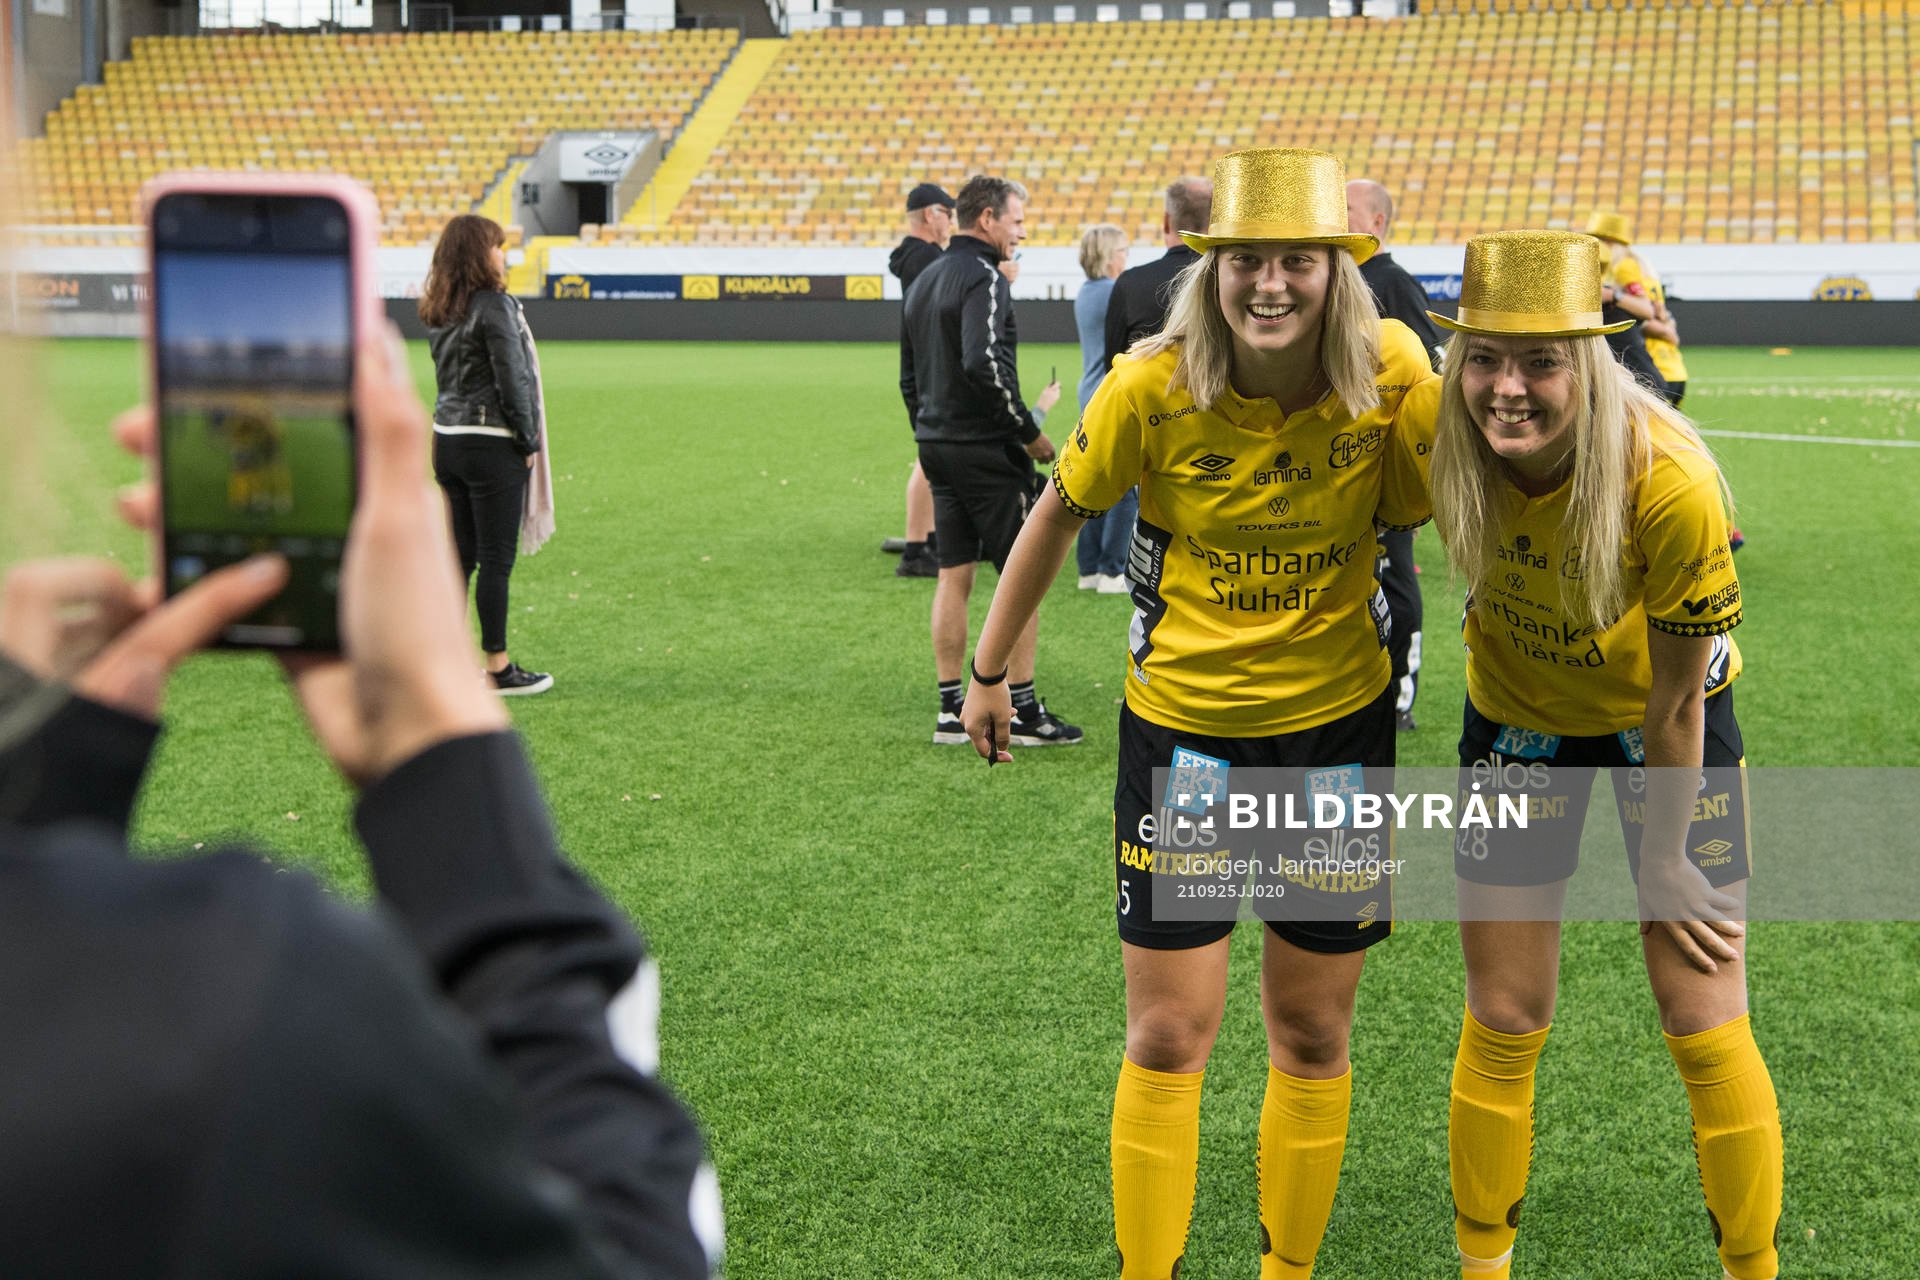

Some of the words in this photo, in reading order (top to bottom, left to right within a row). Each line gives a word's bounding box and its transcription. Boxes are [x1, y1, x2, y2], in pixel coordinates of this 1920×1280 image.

[1328, 428, 1382, 469] Elfsborg
[1195, 471, 1232, 482] umbro
[1253, 465, 1312, 487] lamina
[1236, 521, 1300, 531] TOVEKS
[1303, 519, 1323, 528] BIL
[1498, 545, 1547, 570] amina
[1709, 581, 1739, 604] INTER
[1711, 591, 1740, 614] SPORT
[1176, 750, 1220, 777] EFF
[1472, 751, 1551, 789] ellos
[1174, 767, 1222, 795] EKT
[1309, 768, 1352, 791] EFF
[1138, 806, 1218, 848] ellos
[1120, 841, 1230, 876] RAMIRENT
[1304, 829, 1380, 867] ellos
[1700, 855, 1732, 868] umbro
[1278, 857, 1382, 893] RAMIREN
[1118, 879, 1131, 915] 5
